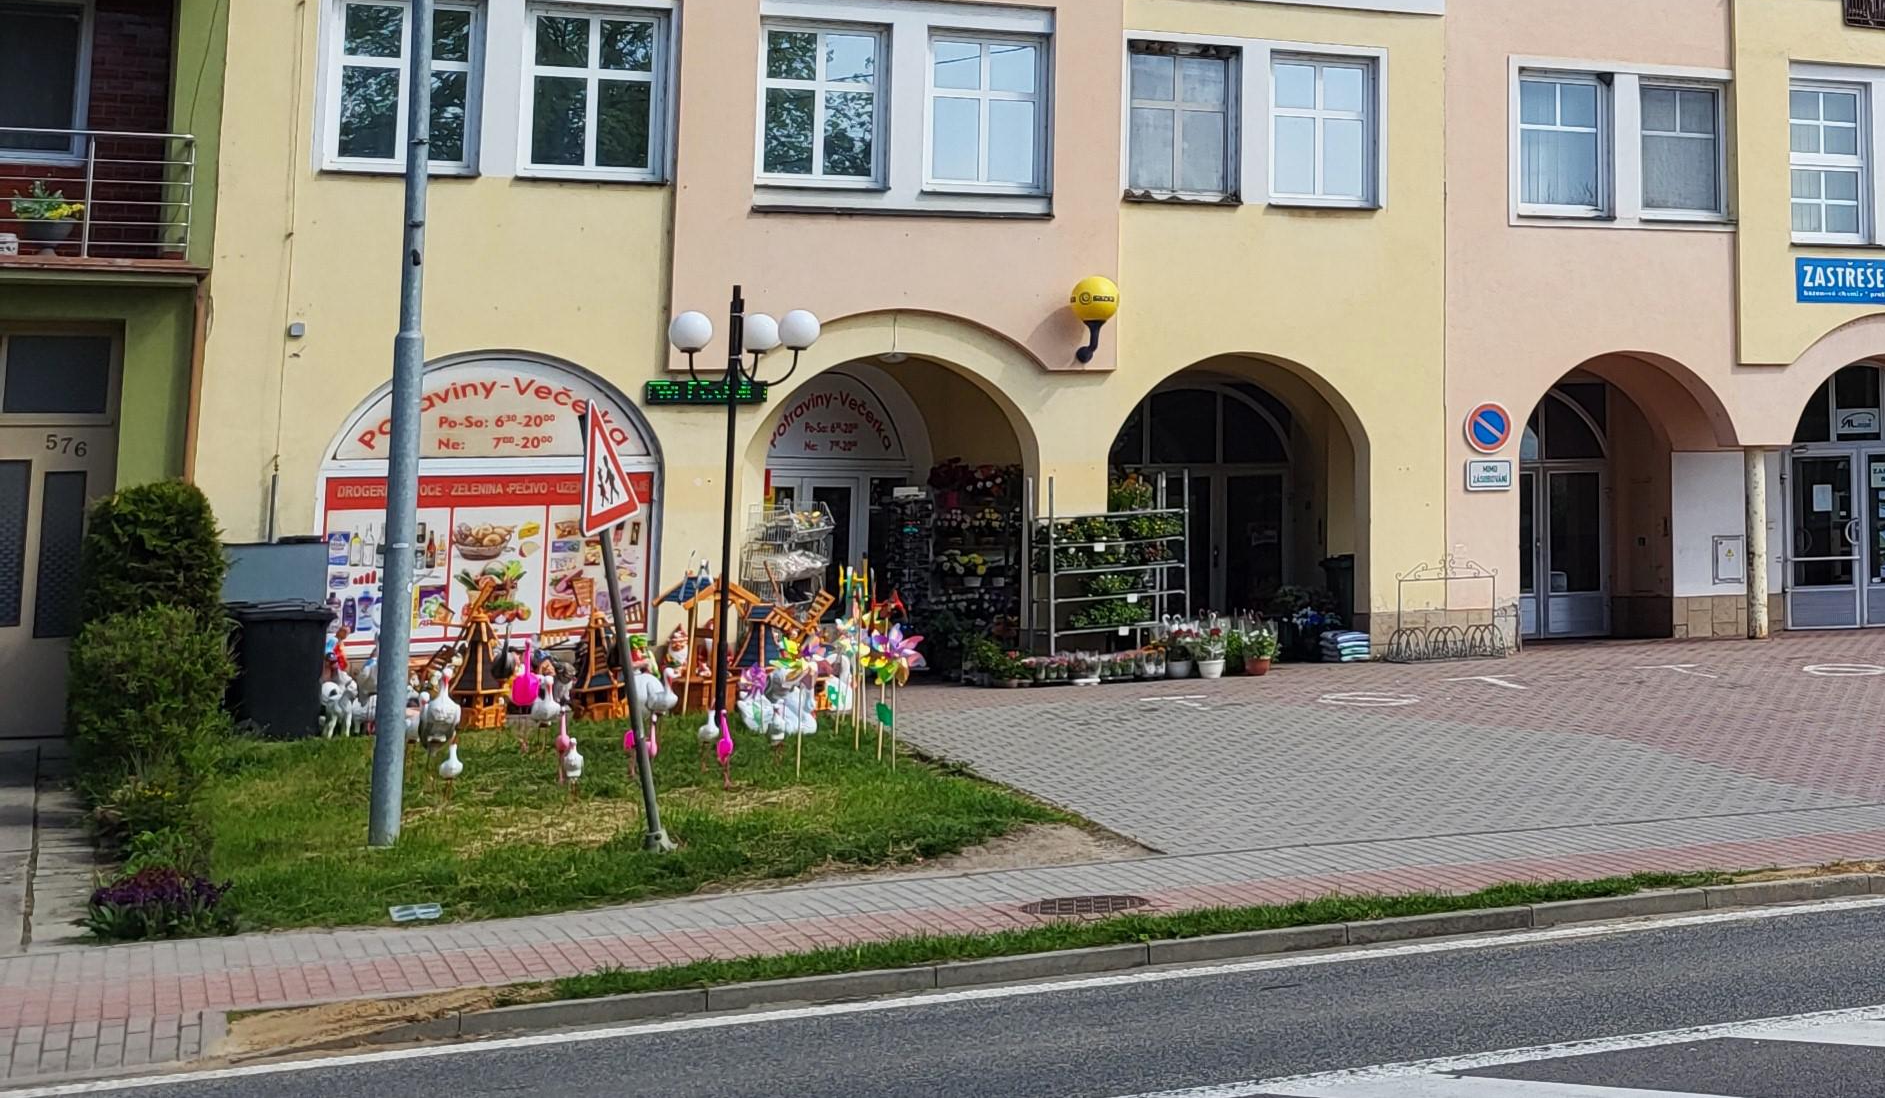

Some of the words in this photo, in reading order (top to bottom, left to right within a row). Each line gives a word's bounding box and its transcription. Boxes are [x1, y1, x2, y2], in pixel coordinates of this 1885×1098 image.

[438, 415, 489, 429] Po-So:
[45, 434, 88, 457] 576
[438, 437, 466, 450] Ne:
[450, 482, 503, 496] ZELENINA
